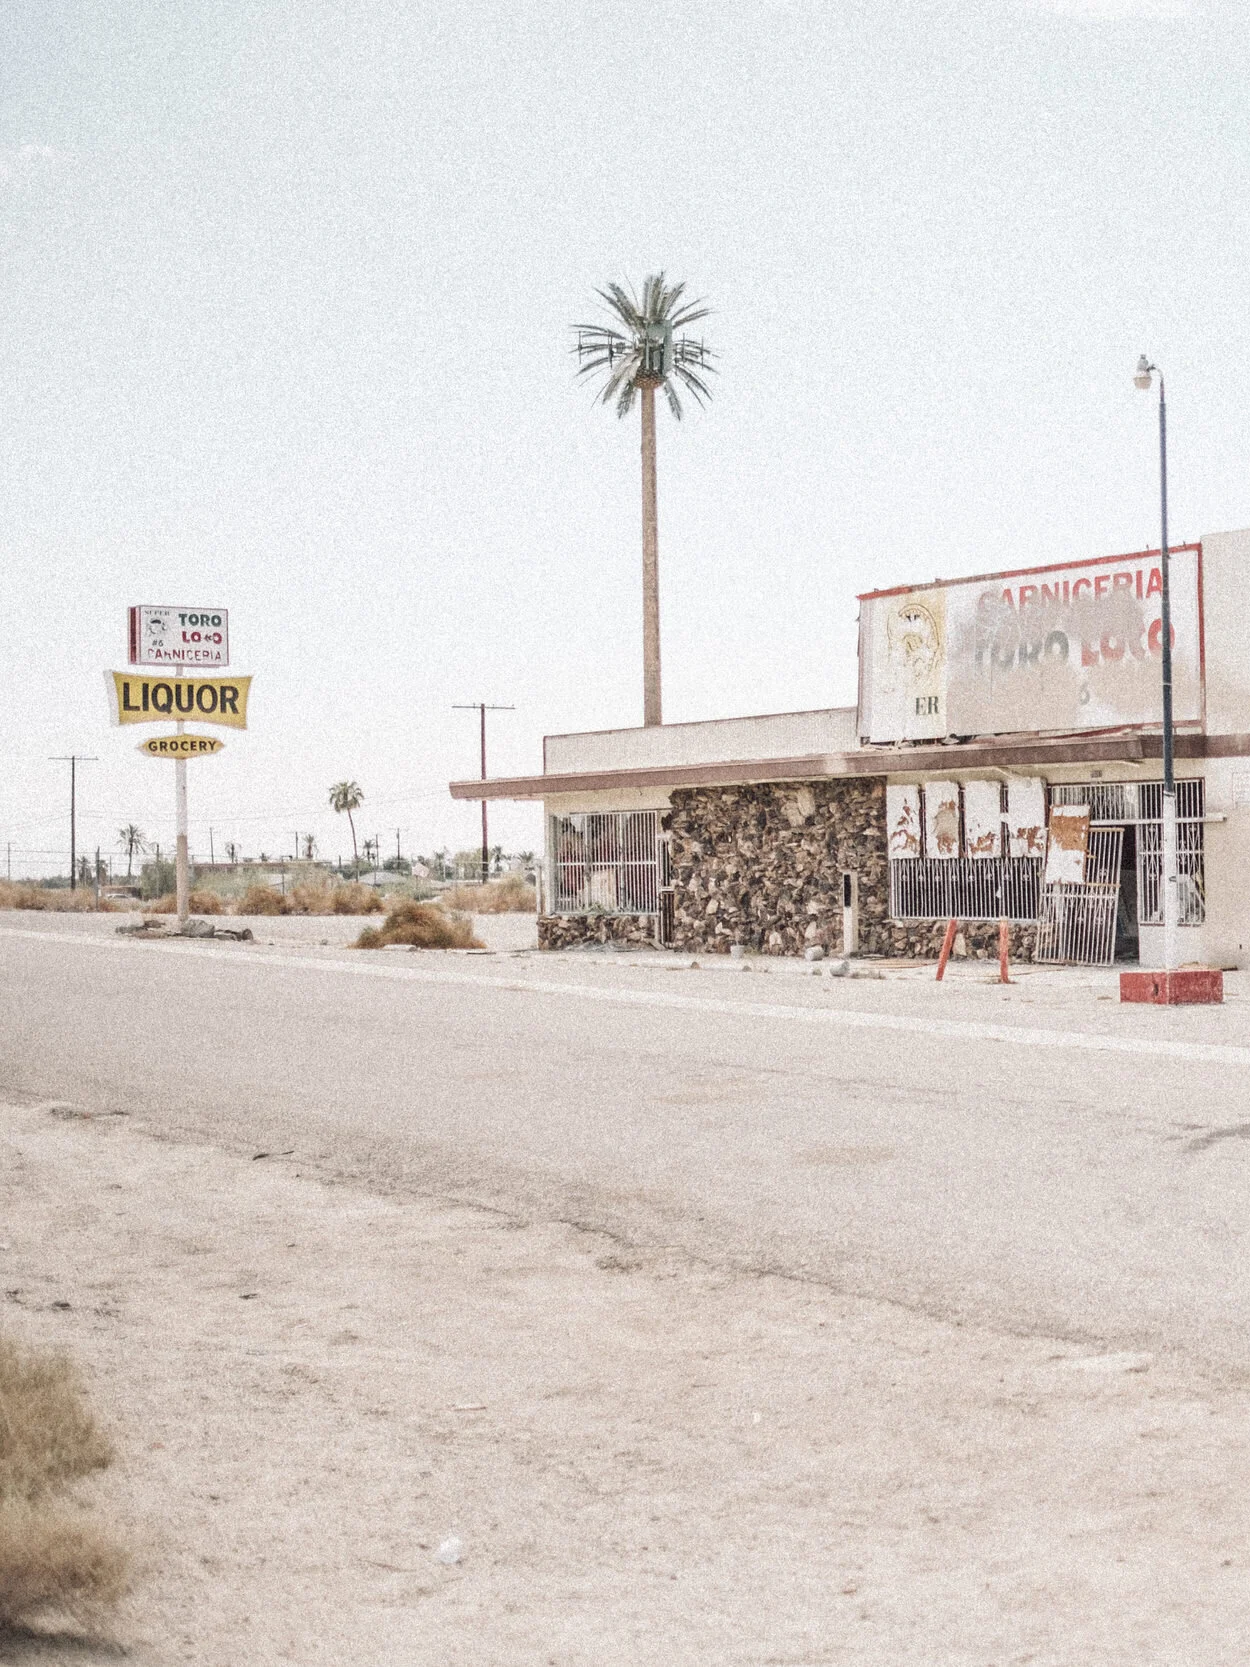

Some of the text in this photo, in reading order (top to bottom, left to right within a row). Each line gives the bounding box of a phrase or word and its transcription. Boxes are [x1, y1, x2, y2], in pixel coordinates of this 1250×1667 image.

[178, 613, 222, 627] TORO
[122, 682, 240, 715] LIQUOR
[148, 740, 217, 752] GROCERY
